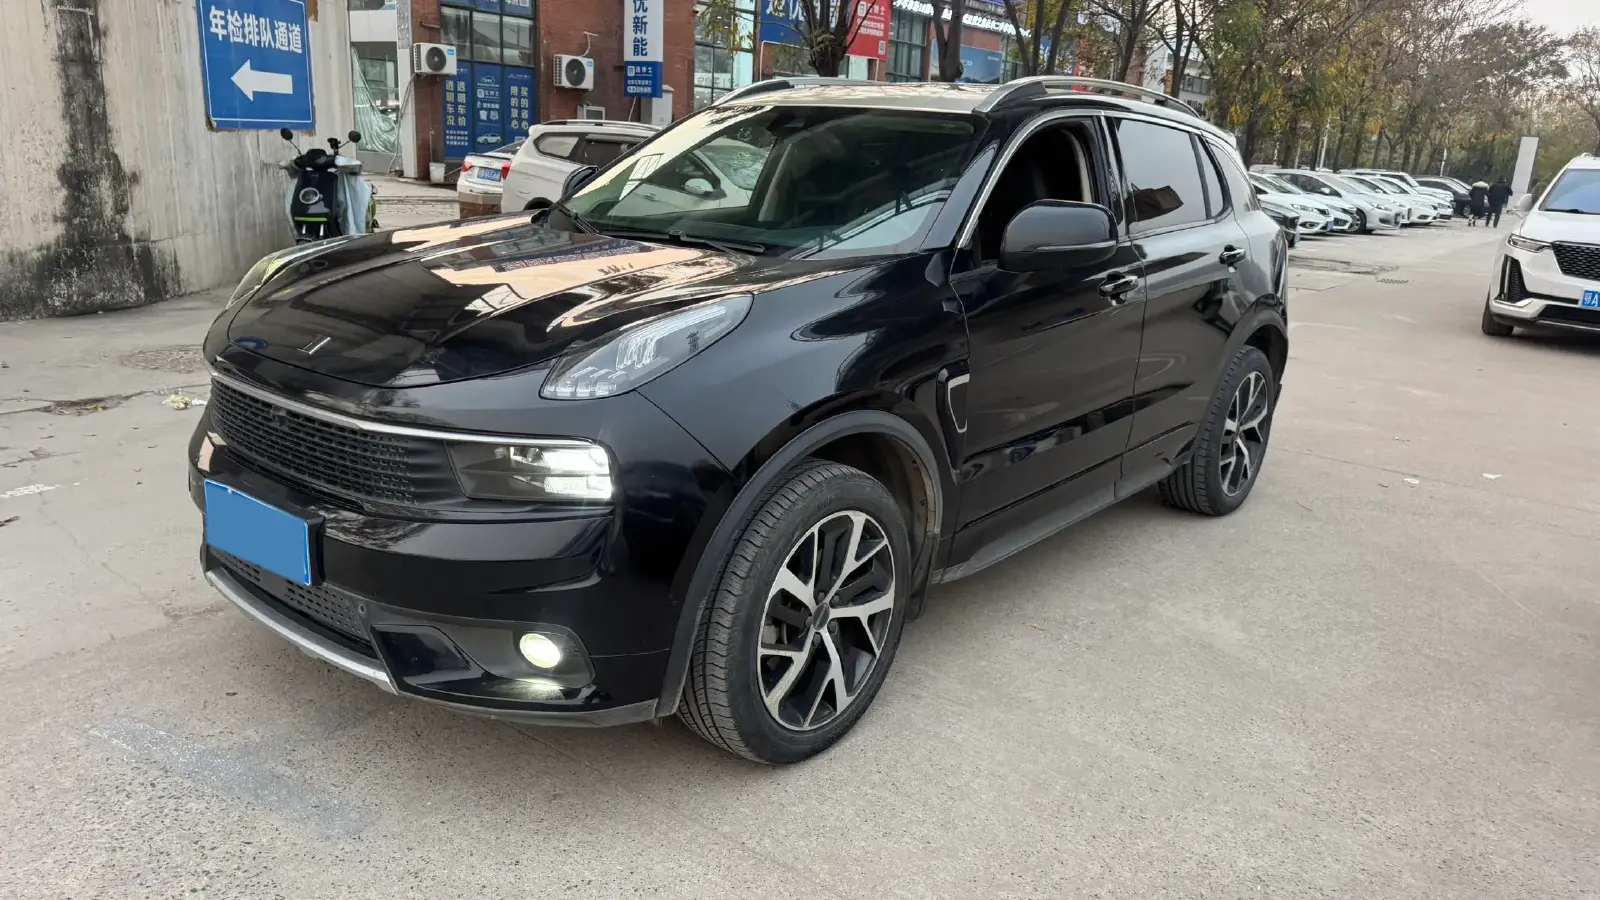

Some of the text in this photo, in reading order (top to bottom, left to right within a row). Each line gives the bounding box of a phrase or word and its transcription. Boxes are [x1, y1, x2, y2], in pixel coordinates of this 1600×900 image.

[209, 5, 302, 53] 年检排队通道
[445, 80, 455, 126] 透明车况
[457, 81, 467, 126] 透明车价
